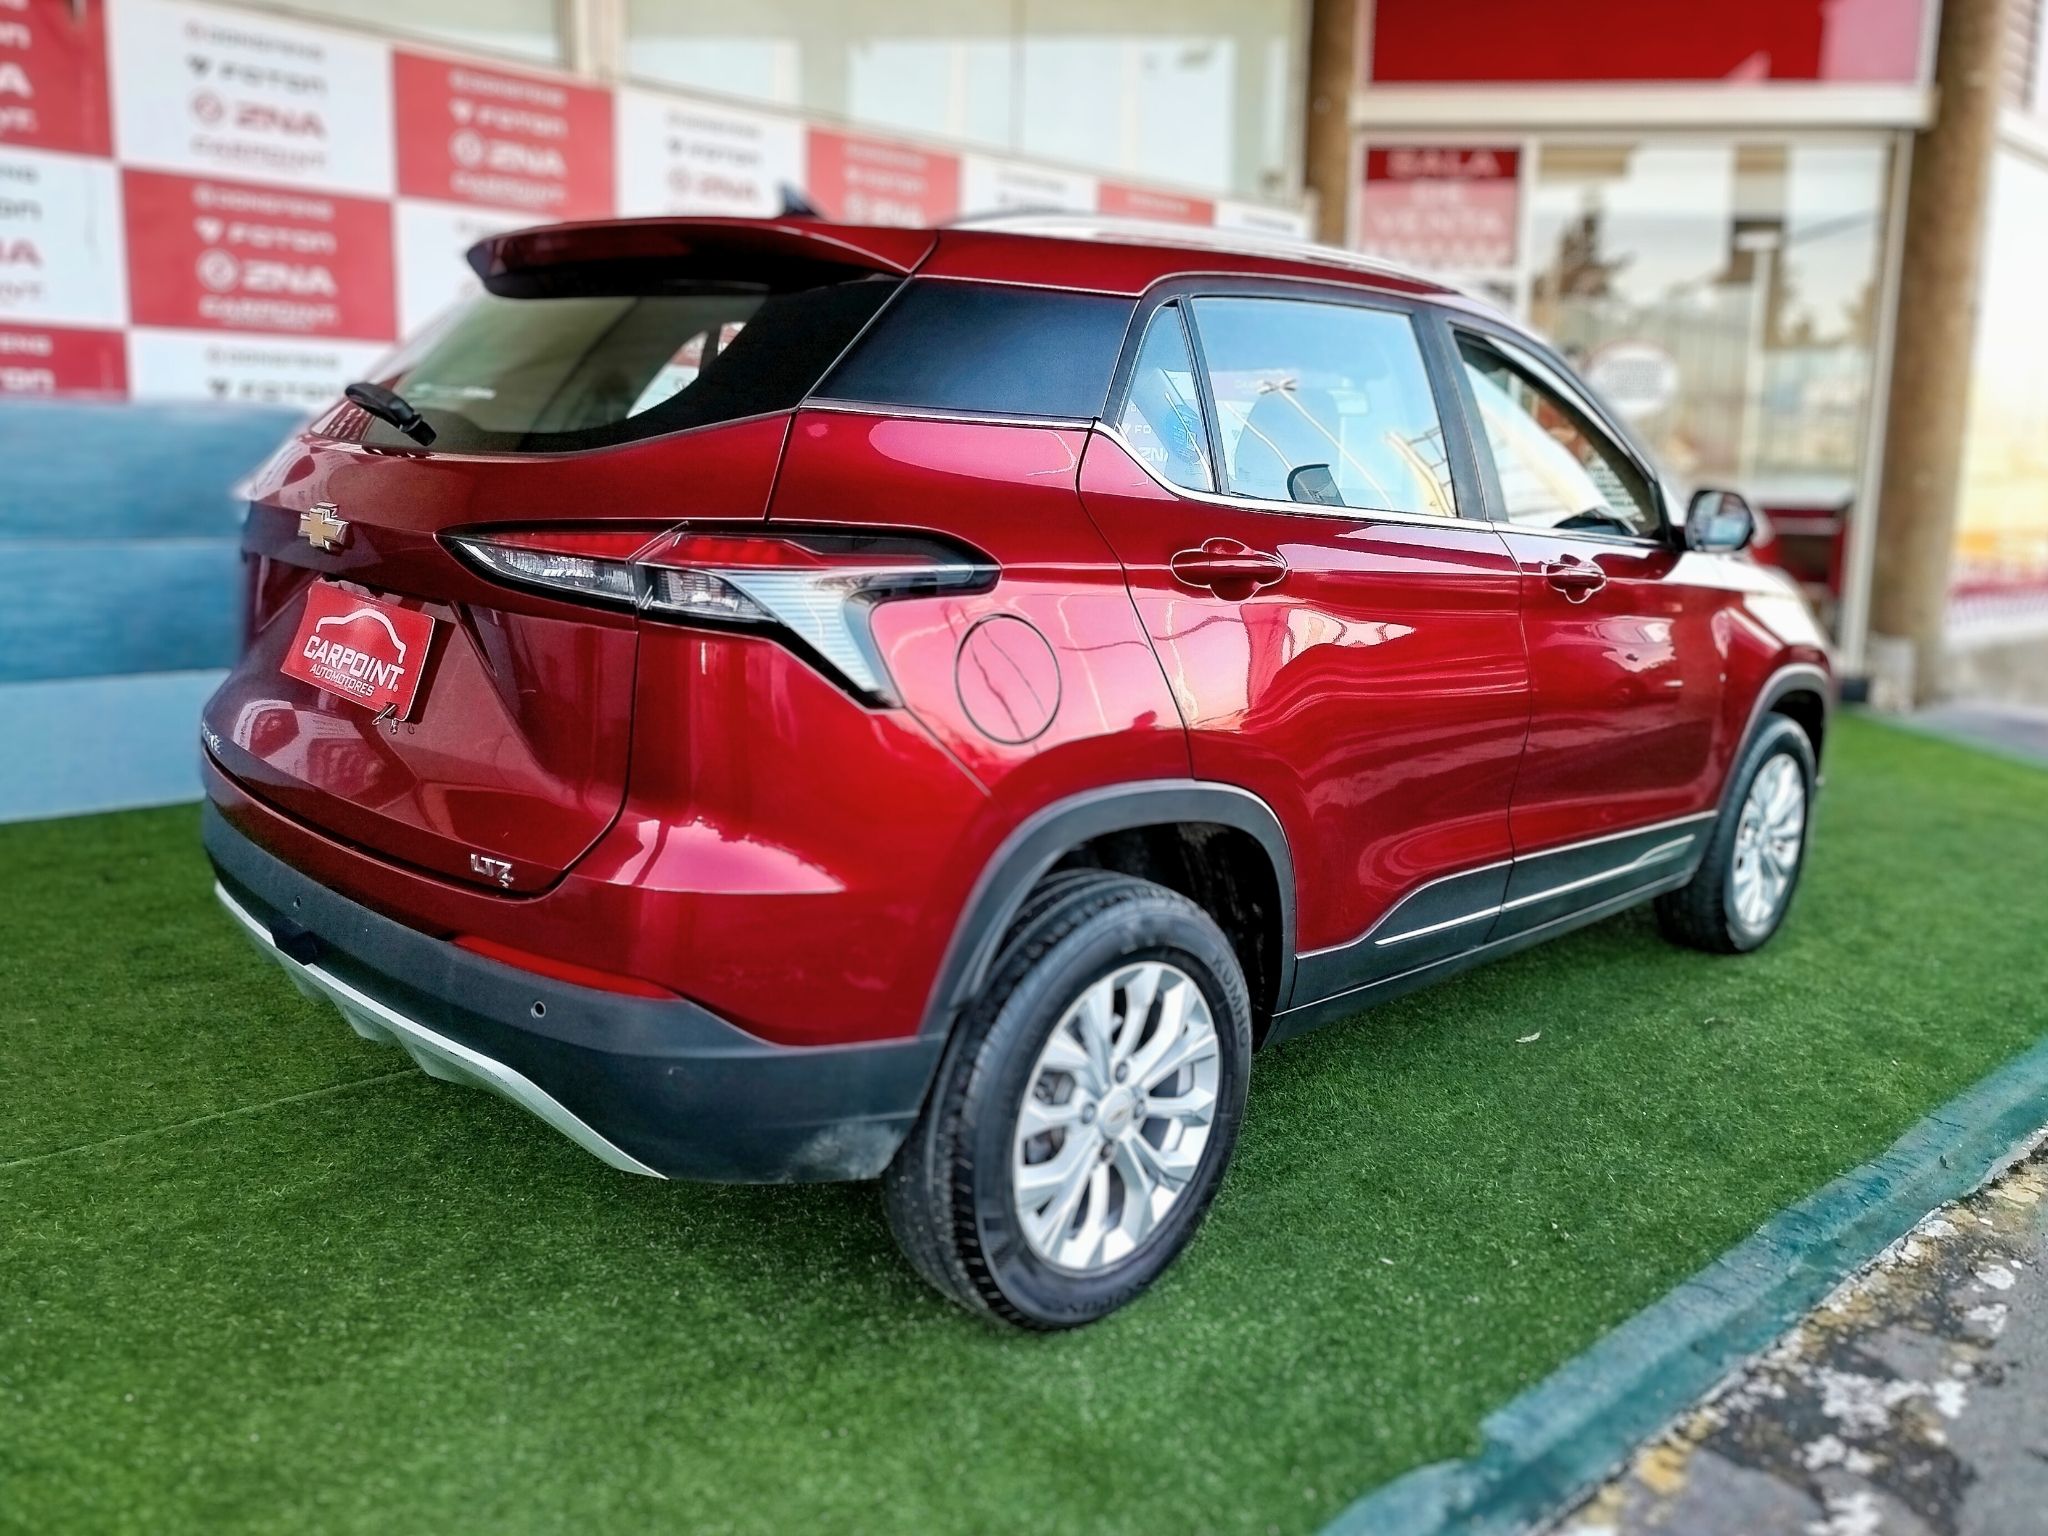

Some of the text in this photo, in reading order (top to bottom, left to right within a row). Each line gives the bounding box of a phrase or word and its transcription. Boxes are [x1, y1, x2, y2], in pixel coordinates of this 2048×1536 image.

[303, 635, 405, 690] CARPOINT
[310, 663, 375, 697] AUTOMOTORES
[470, 853, 514, 884] LTZ
